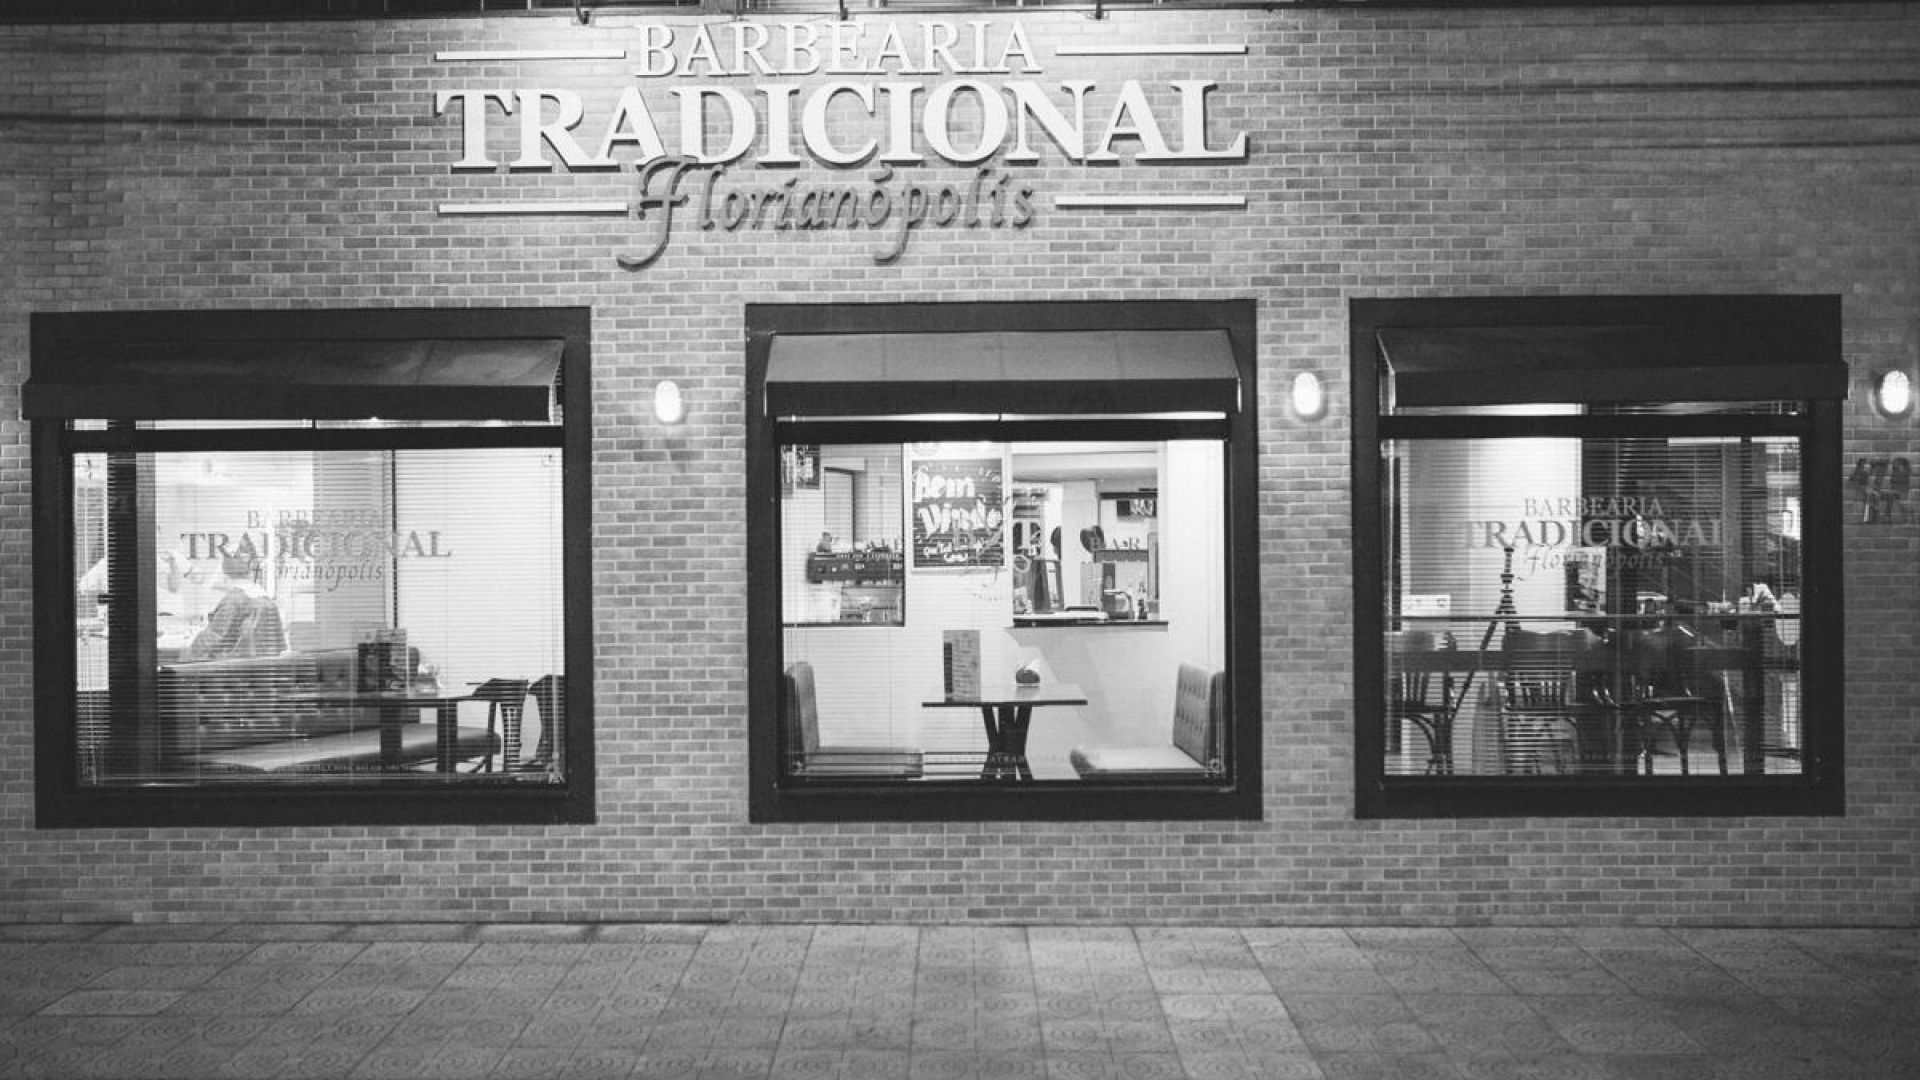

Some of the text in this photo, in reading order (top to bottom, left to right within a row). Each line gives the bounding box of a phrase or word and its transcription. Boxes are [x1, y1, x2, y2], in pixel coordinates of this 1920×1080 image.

[634, 20, 1042, 77] BARBEARIA
[436, 79, 1247, 170] TRADICIONAL
[617, 157, 1034, 270] Florianópolis
[1525, 496, 1664, 517] BARBEARIA
[180, 531, 451, 560] TRADICIONAL
[248, 557, 384, 592] Frianópolis
